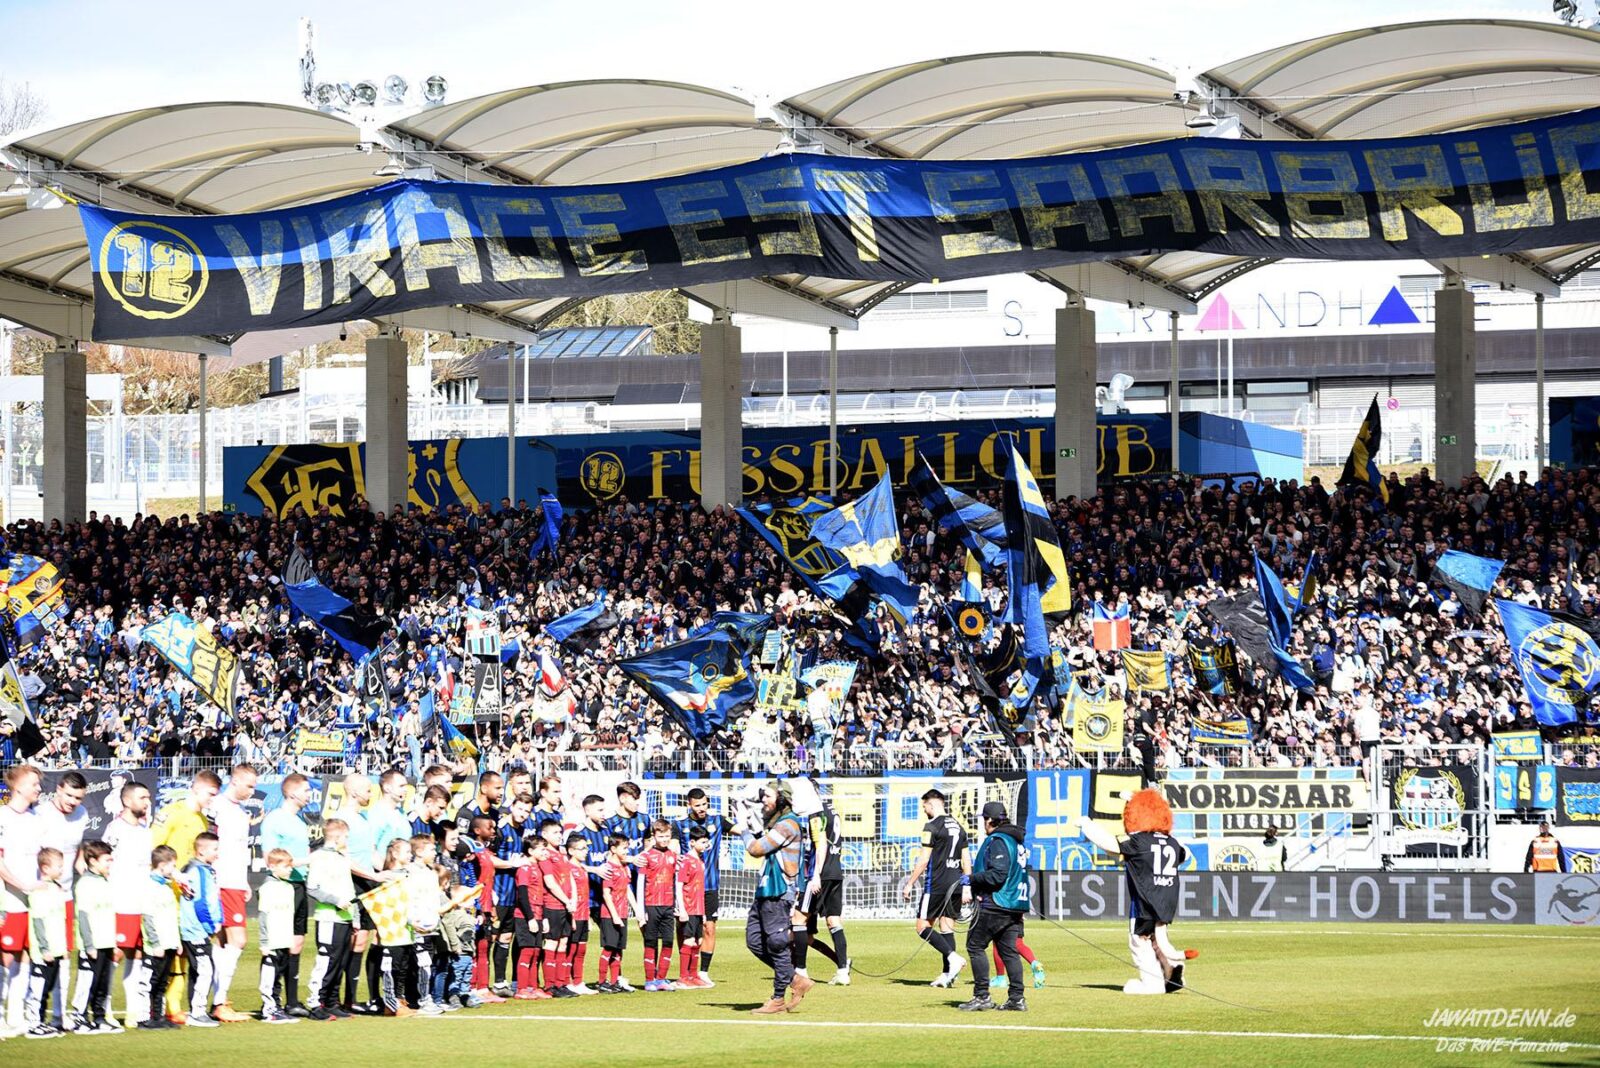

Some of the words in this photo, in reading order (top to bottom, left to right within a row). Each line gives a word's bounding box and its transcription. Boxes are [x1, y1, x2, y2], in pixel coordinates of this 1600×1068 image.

[115, 234, 193, 304] 12
[215, 193, 649, 316] VIRAGE
[656, 166, 888, 263] EST
[587, 457, 619, 493] 12
[1164, 783, 1354, 809] NORDSAAR
[1226, 814, 1295, 829] JUGEND
[948, 828, 960, 858] 7
[1151, 844, 1177, 876] 12
[1028, 874, 1518, 920] ESIENZ-HOTELS
